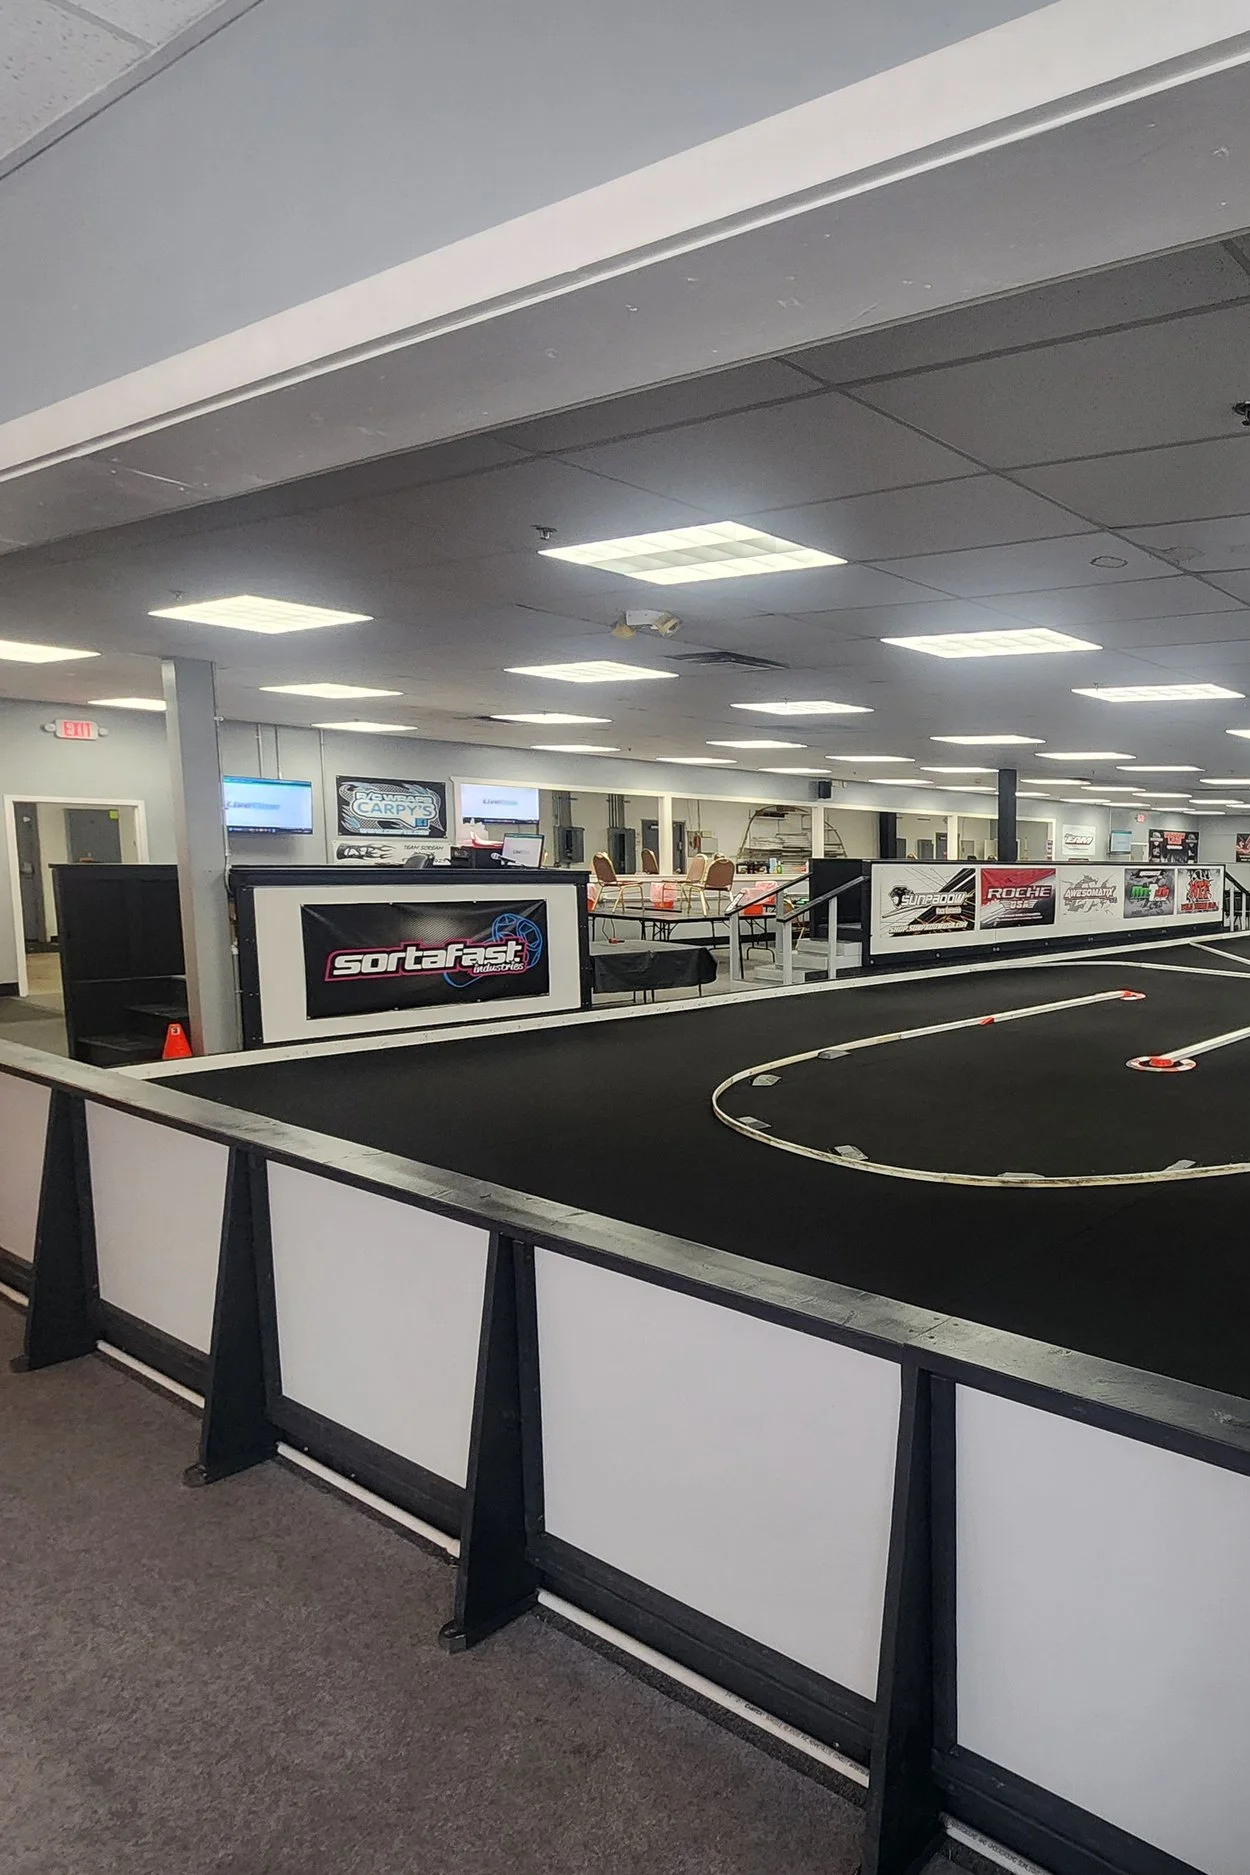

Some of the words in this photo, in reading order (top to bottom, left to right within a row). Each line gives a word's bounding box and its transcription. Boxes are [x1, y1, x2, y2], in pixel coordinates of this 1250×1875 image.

[63, 721, 91, 738] EXIT
[357, 801, 433, 817] CARPY'S
[987, 886, 1051, 899] ROCHE
[1064, 887, 1115, 898] AWESOMATIX
[1009, 900, 1029, 908] USA
[333, 940, 523, 975] sortafast
[472, 960, 524, 974] industries
